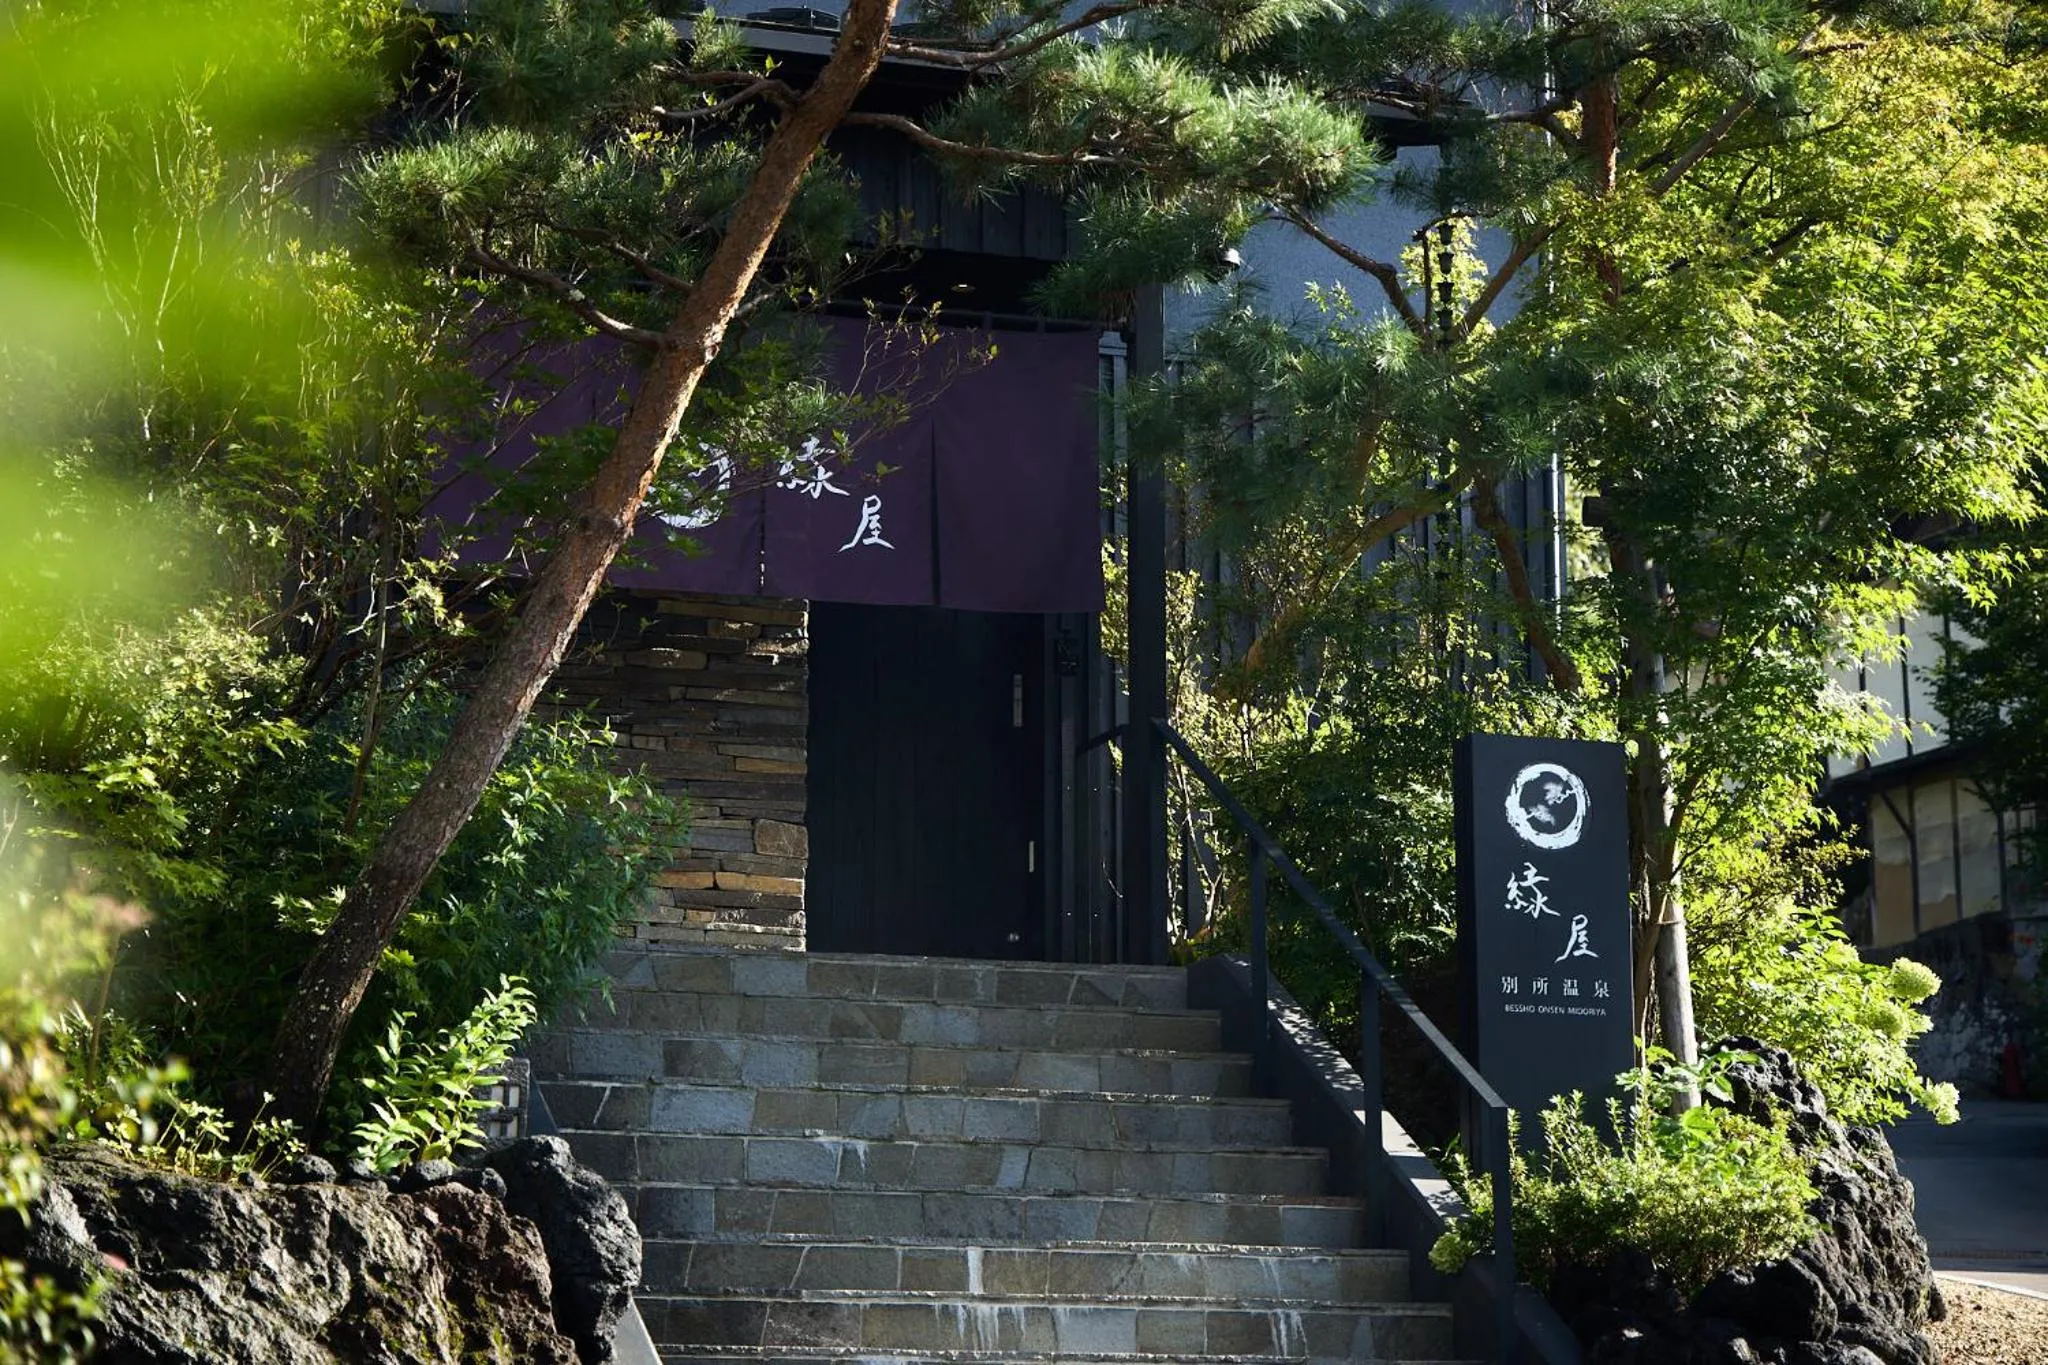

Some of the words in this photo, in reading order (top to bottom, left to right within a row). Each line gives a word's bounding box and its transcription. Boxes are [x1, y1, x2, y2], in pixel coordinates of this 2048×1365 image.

[1501, 976, 1610, 998] 別所温泉
[1504, 1004, 1536, 1013] BESSHO
[1538, 1005, 1565, 1015] ONSEN
[1567, 1007, 1607, 1016] MIDORIYA
